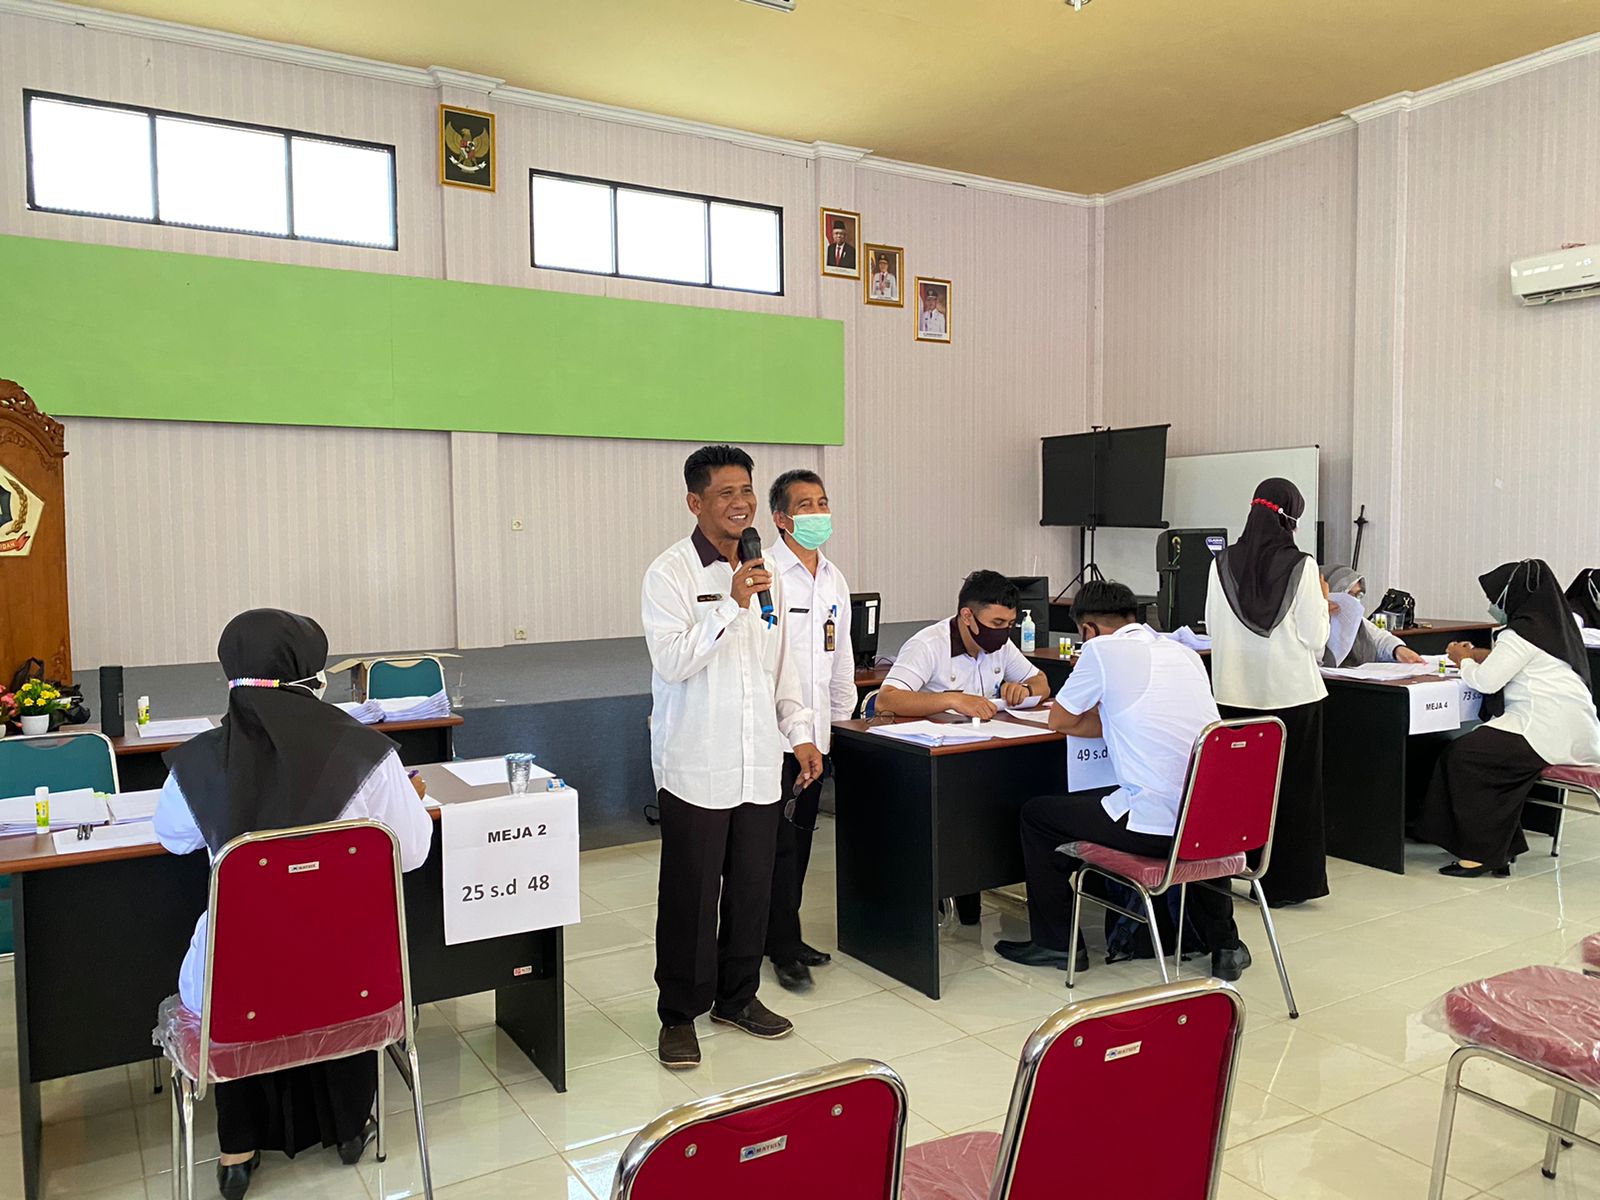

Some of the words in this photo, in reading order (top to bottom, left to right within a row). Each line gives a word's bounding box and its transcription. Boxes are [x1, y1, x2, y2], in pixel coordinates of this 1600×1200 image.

[1463, 691, 1471, 701] 73
[1425, 702, 1443, 711] MEJA
[1077, 748, 1090, 761] 49
[1093, 745, 1108, 760] s.d
[487, 826, 533, 843] MEJA
[537, 824, 547, 836] 2
[462, 883, 484, 902] 25
[490, 878, 517, 898] s.d
[527, 874, 550, 892] 48
